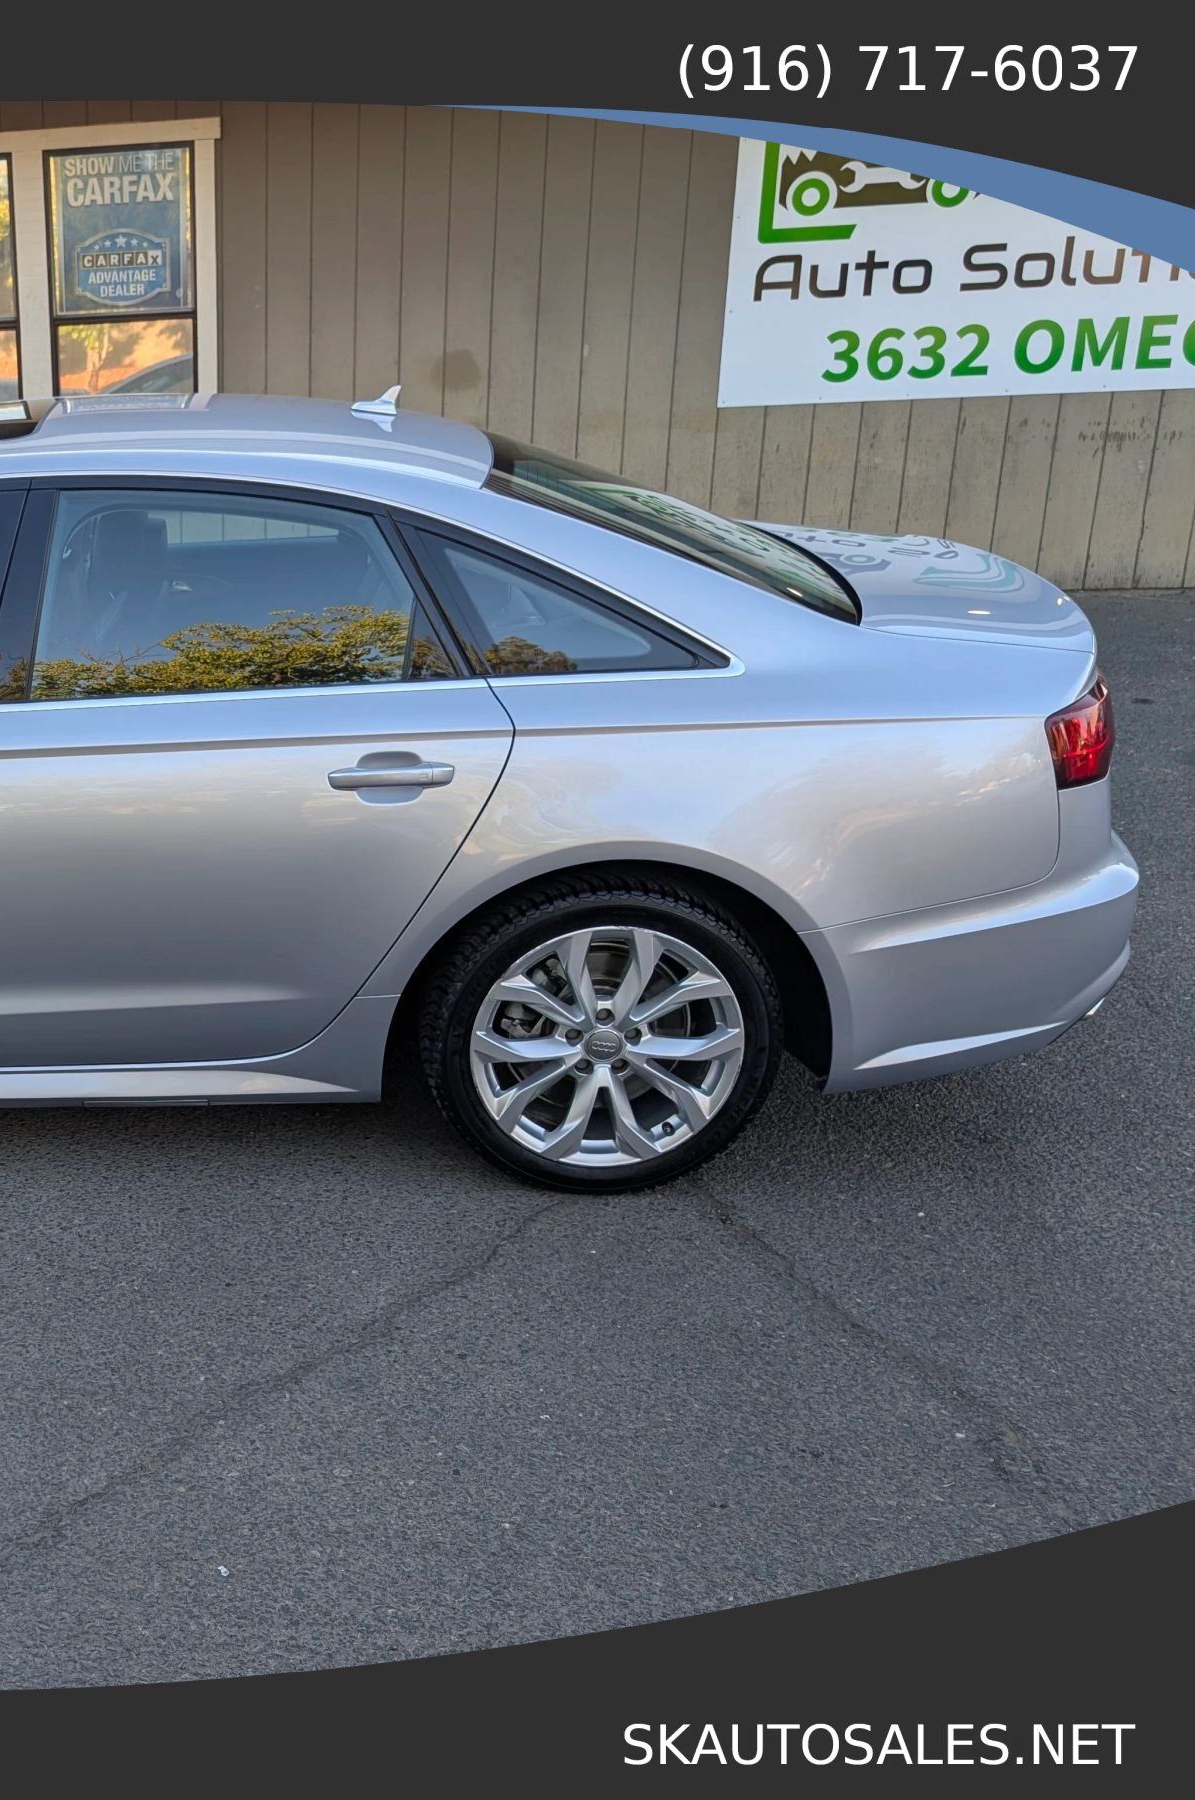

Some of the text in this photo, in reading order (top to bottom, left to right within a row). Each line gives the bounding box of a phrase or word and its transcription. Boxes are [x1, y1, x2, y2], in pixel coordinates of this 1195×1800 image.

[64, 152, 175, 177] SHOW ME THE
[67, 172, 176, 208] CARFAX
[82, 250, 162, 269] CARFAX
[88, 269, 157, 285] ADVANTAGE
[753, 250, 933, 302] Auto
[100, 284, 145, 298] DEALER
[821, 314, 1195, 383] 3632 OME
